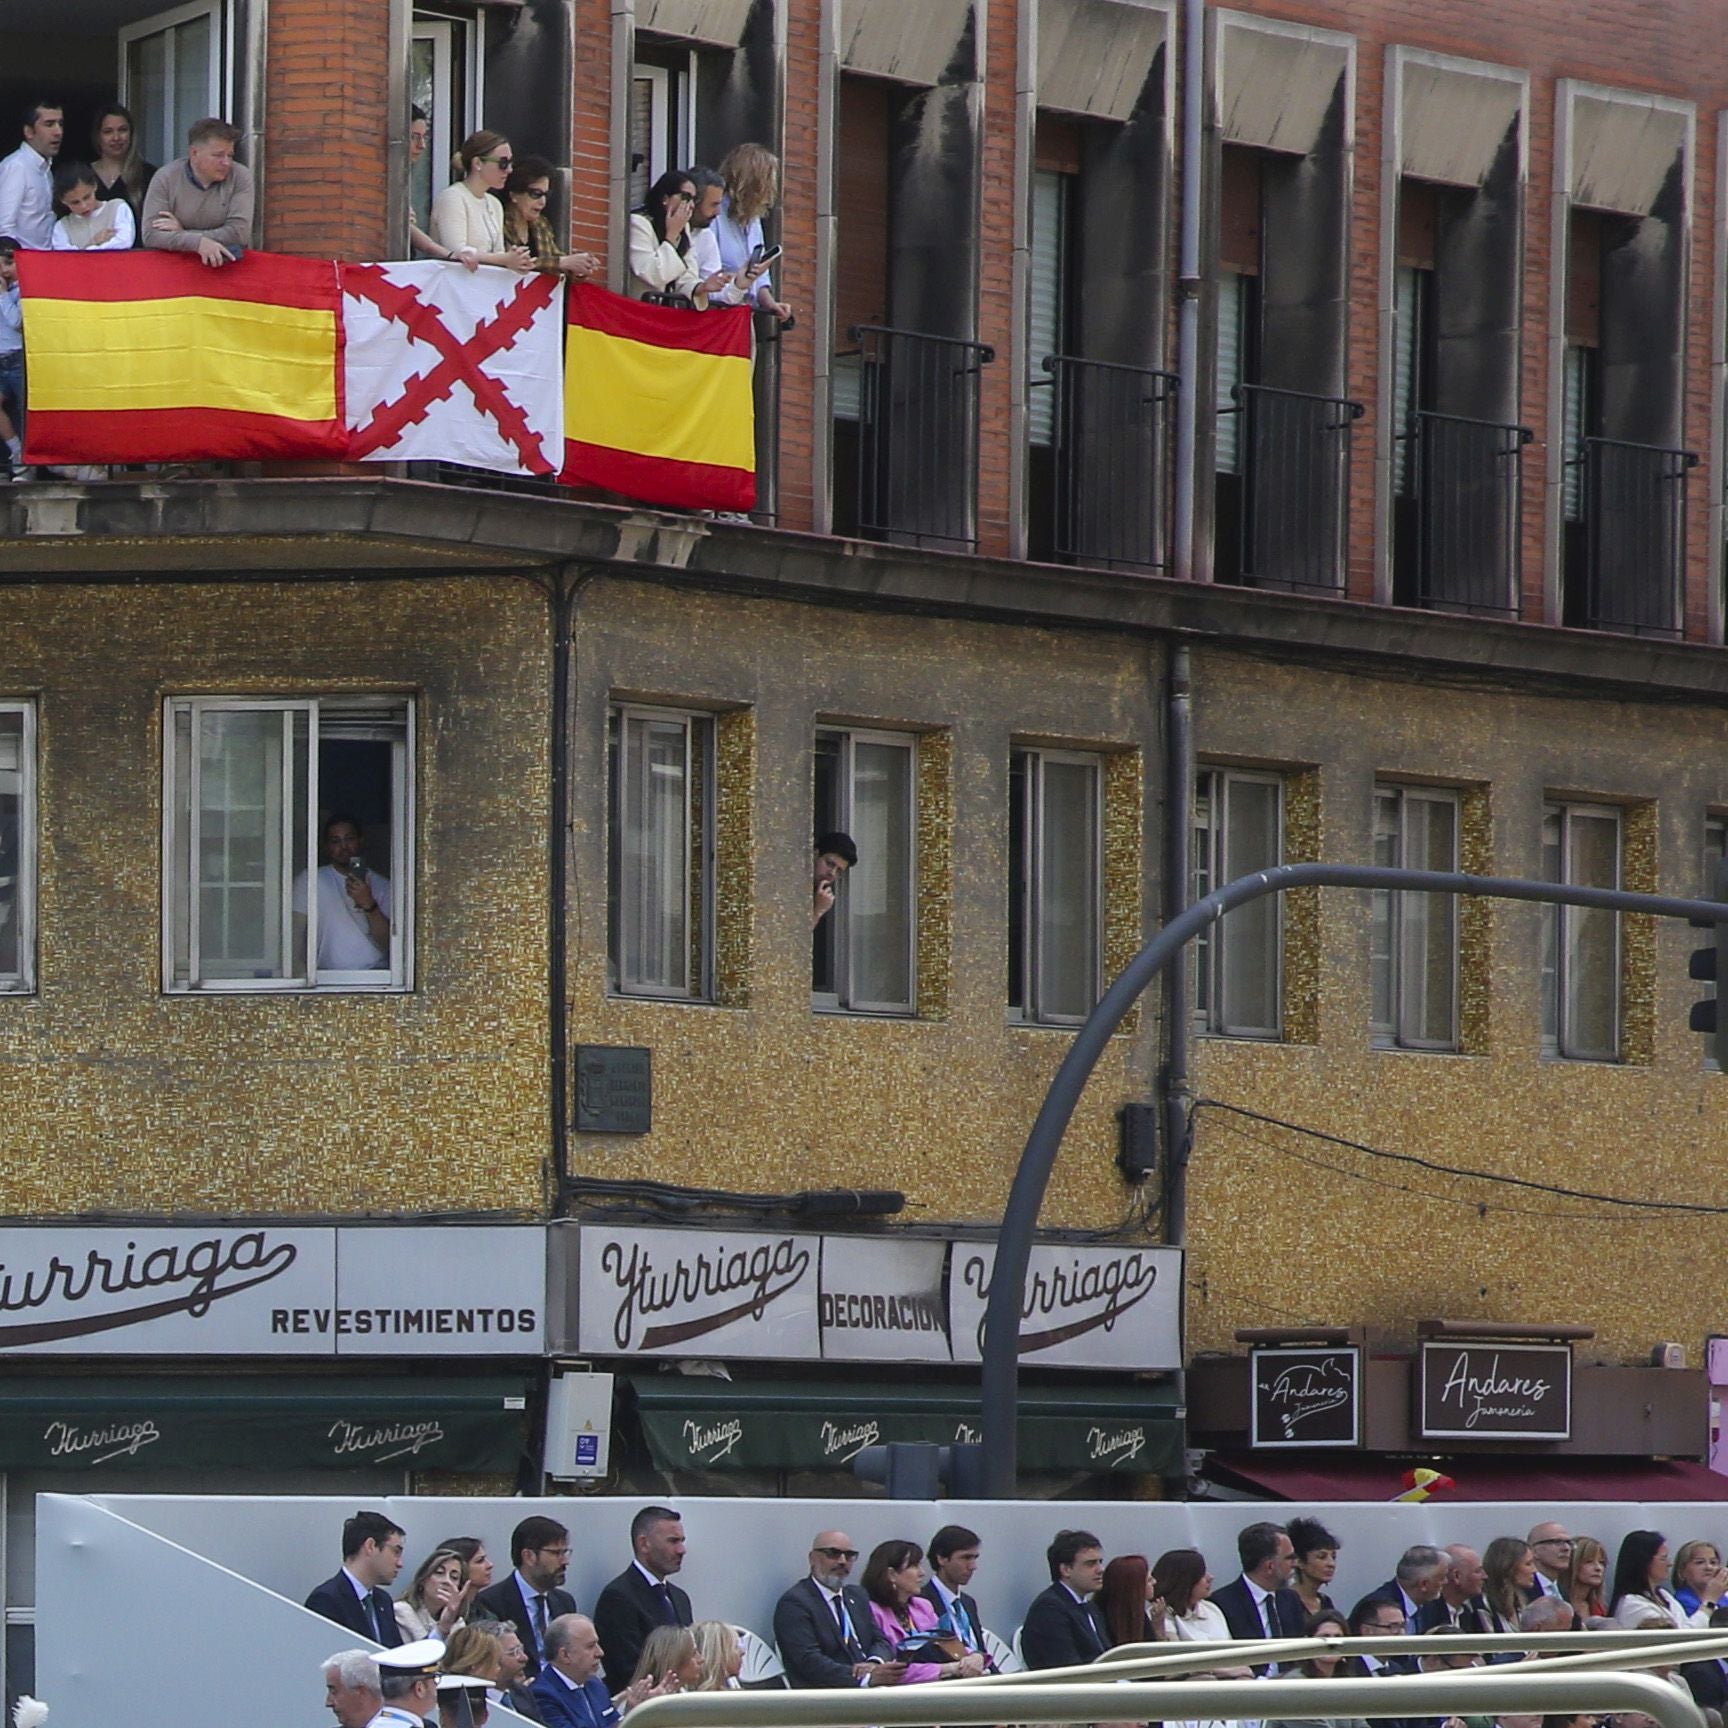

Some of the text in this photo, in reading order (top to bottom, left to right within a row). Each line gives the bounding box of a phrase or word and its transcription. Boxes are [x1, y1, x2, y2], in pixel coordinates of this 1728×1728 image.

[602, 1237, 810, 1350] Yturriaga
[820, 1293, 947, 1332] DECORACION
[964, 1253, 1156, 1355] Yrriaga
[271, 1308, 536, 1334] REVESTIMIENTOS
[1269, 1374, 1345, 1404] Andares
[1441, 1351, 1551, 1408] Andares
